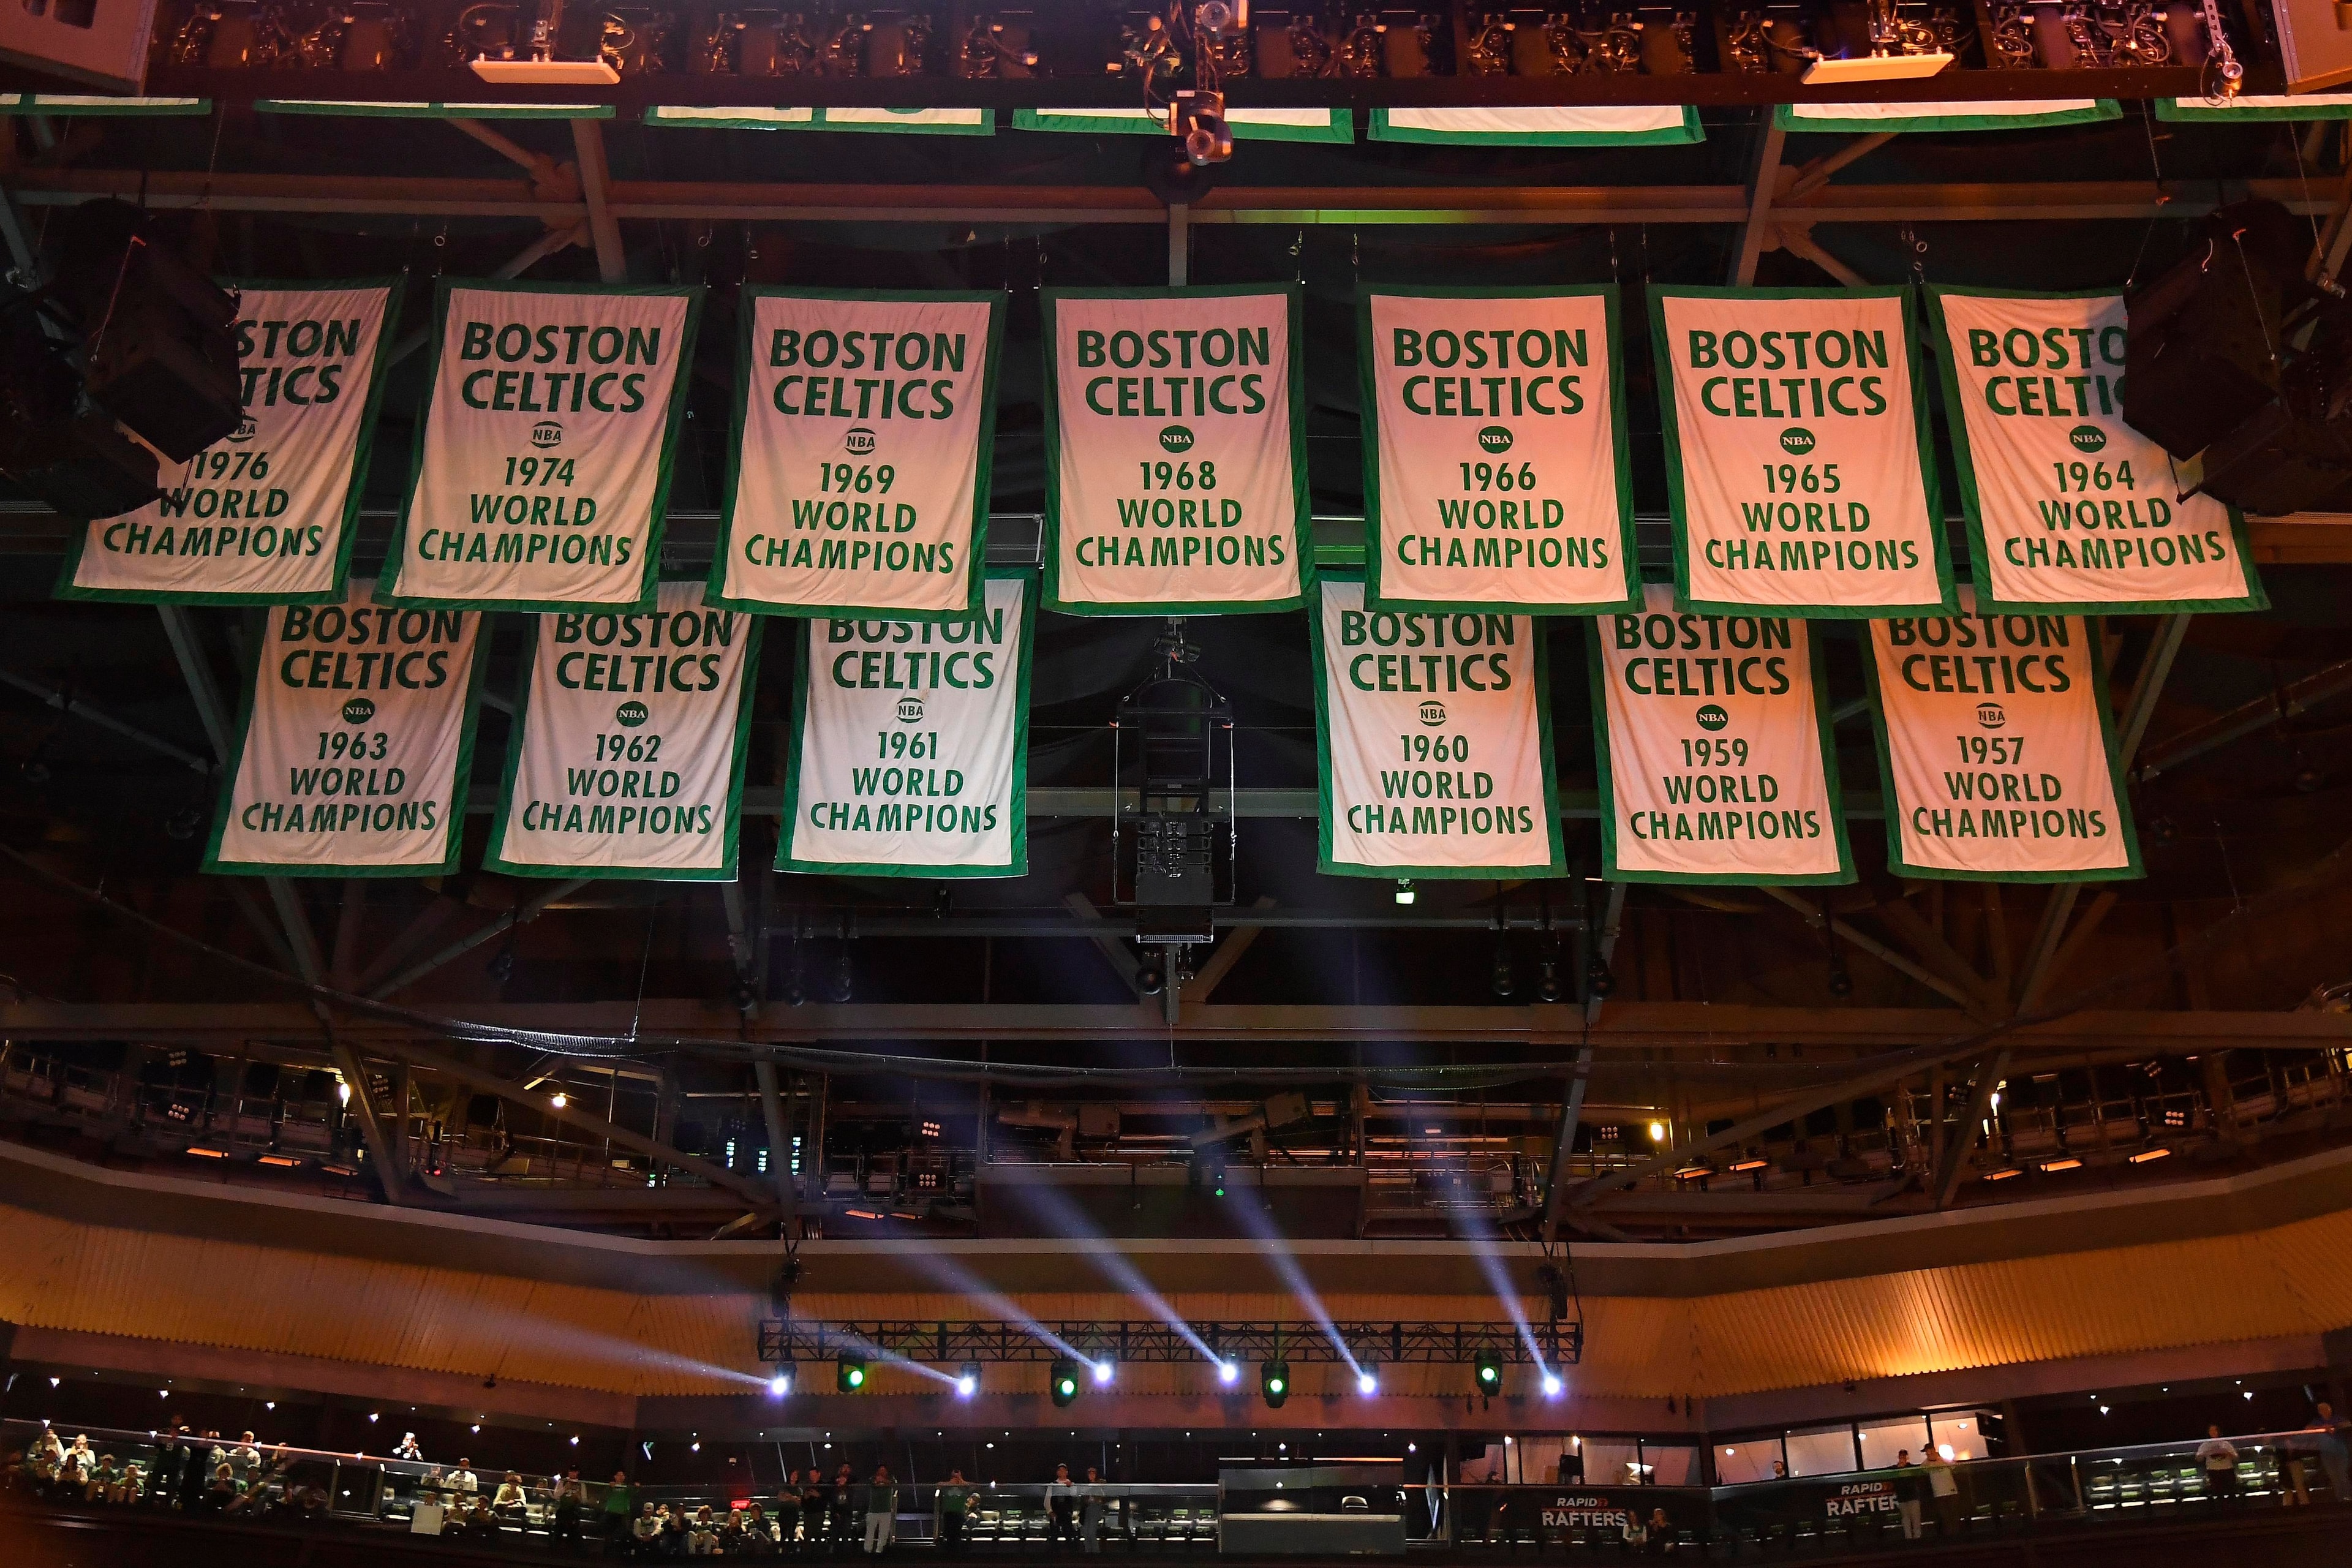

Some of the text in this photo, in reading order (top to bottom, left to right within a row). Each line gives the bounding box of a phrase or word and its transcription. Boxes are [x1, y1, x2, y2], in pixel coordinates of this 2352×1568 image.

[236, 318, 361, 358] STON
[461, 322, 660, 365] BOSTON
[770, 330, 965, 372] BOSTON
[1078, 327, 1269, 369] BOSTON
[1394, 328, 1588, 369] BOSTON
[1689, 330, 1888, 370] BOSTON
[1968, 326, 2127, 370] BOSTO
[240, 364, 342, 407] TICS
[462, 369, 645, 413] CELTICS
[774, 375, 953, 420] CELTICS
[1086, 374, 1265, 417] CELTICS
[1403, 375, 1583, 417] CELTICS
[1702, 377, 1886, 418] CELTICS
[1985, 375, 2125, 417] CELTI
[533, 428, 561, 441] NBA
[846, 435, 875, 448] NBA
[1162, 434, 1191, 443] NBA
[1481, 435, 1510, 444] NBA
[1782, 436, 1814, 445] NBA
[2073, 434, 2104, 443] NBA
[194, 451, 268, 480] 1976
[505, 457, 575, 486] 1974
[821, 463, 894, 494] 1969
[1140, 461, 1216, 490] 1968
[1460, 462, 1536, 491] 1966
[1763, 464, 1840, 493] 1965
[2054, 461, 2135, 492] 1964
[160, 489, 290, 519] WORLD
[471, 494, 596, 526] WORLD
[793, 500, 916, 532] WORLD
[1117, 499, 1242, 528] WORLD
[1438, 499, 1564, 529] WORLD
[1741, 502, 1869, 532] WORLD
[2038, 498, 2171, 530] WORLD
[104, 522, 322, 557] CHAMPIONS
[419, 529, 631, 565] CHAMPIONS
[745, 534, 953, 573] CHAMPIONS
[1076, 535, 1284, 567] CHAMPIONS
[1398, 535, 1608, 568] CHAMPIONS
[1706, 539, 1918, 571] CHAMPIONS
[2005, 531, 2225, 569] CHAMPIONS
[281, 606, 462, 645] BOSTON
[555, 611, 733, 649] BOSTON
[828, 608, 1003, 645] BOSTON
[1341, 611, 1515, 647] BOSTON
[1616, 615, 1792, 650] BOSTON
[1890, 613, 2070, 648] BOSTON
[281, 649, 448, 690] CELTICS
[557, 652, 720, 692] CELTICS
[832, 651, 993, 689] CELTICS
[1349, 653, 1511, 692] CELTICS
[1625, 657, 1789, 696] CELTICS
[1902, 654, 2070, 693] CELTICS
[345, 706, 372, 715] NBA
[619, 710, 646, 718] NBA
[898, 706, 924, 716] NBA
[1420, 709, 1446, 719] NBA
[1698, 713, 1726, 722] NBA
[1978, 710, 2005, 721] NBA
[318, 732, 387, 760] 1963
[597, 734, 661, 762] 1962
[878, 732, 937, 760] 1961
[1401, 735, 1468, 762] 1960
[1681, 739, 1748, 766] 1959
[1957, 736, 2024, 764] 1957
[291, 768, 405, 796] WORLD
[568, 768, 680, 797] WORLD
[853, 768, 963, 796] WORLD
[1381, 771, 1493, 799] WORLD
[1663, 775, 1777, 804] WORLD
[1944, 772, 2061, 801] WORLD
[243, 801, 436, 832] CHAMPIONS
[523, 801, 710, 834] CHAMPIONS
[811, 802, 996, 833] CHAMPIONS
[1348, 805, 1532, 834] CHAMPIONS
[1630, 810, 1820, 840] CHAMPIONS
[1913, 807, 2106, 839] CHAMPIONS
[1542, 1510, 1627, 1526] RAFTERS
[1826, 1494, 1899, 1516] RAFTER
